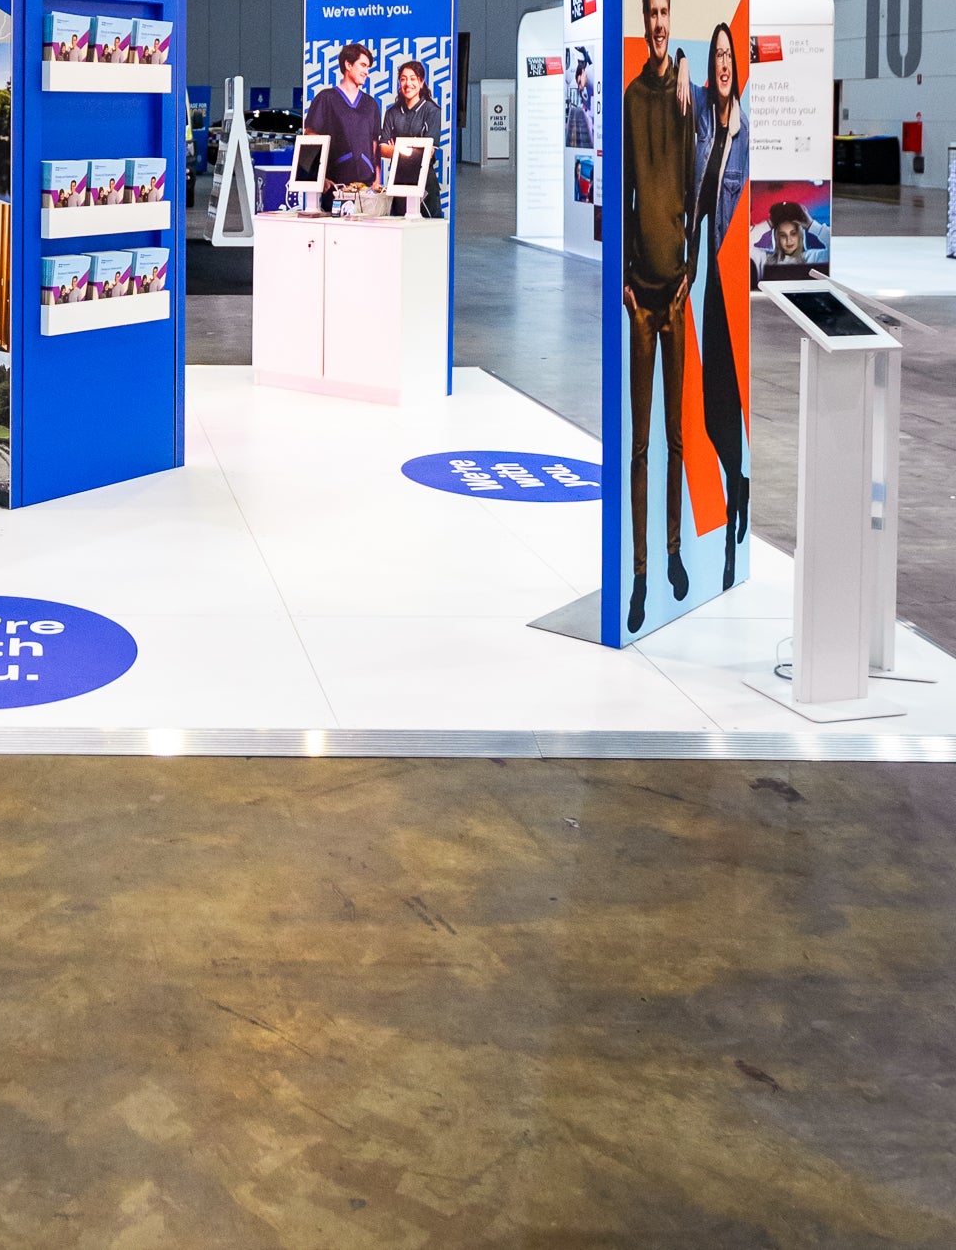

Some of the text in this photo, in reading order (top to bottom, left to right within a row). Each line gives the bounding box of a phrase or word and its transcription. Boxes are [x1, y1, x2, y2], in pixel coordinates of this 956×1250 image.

[323, 4, 412, 18] We're with you.
[449, 459, 503, 491] We're
[491, 463, 545, 488] with
